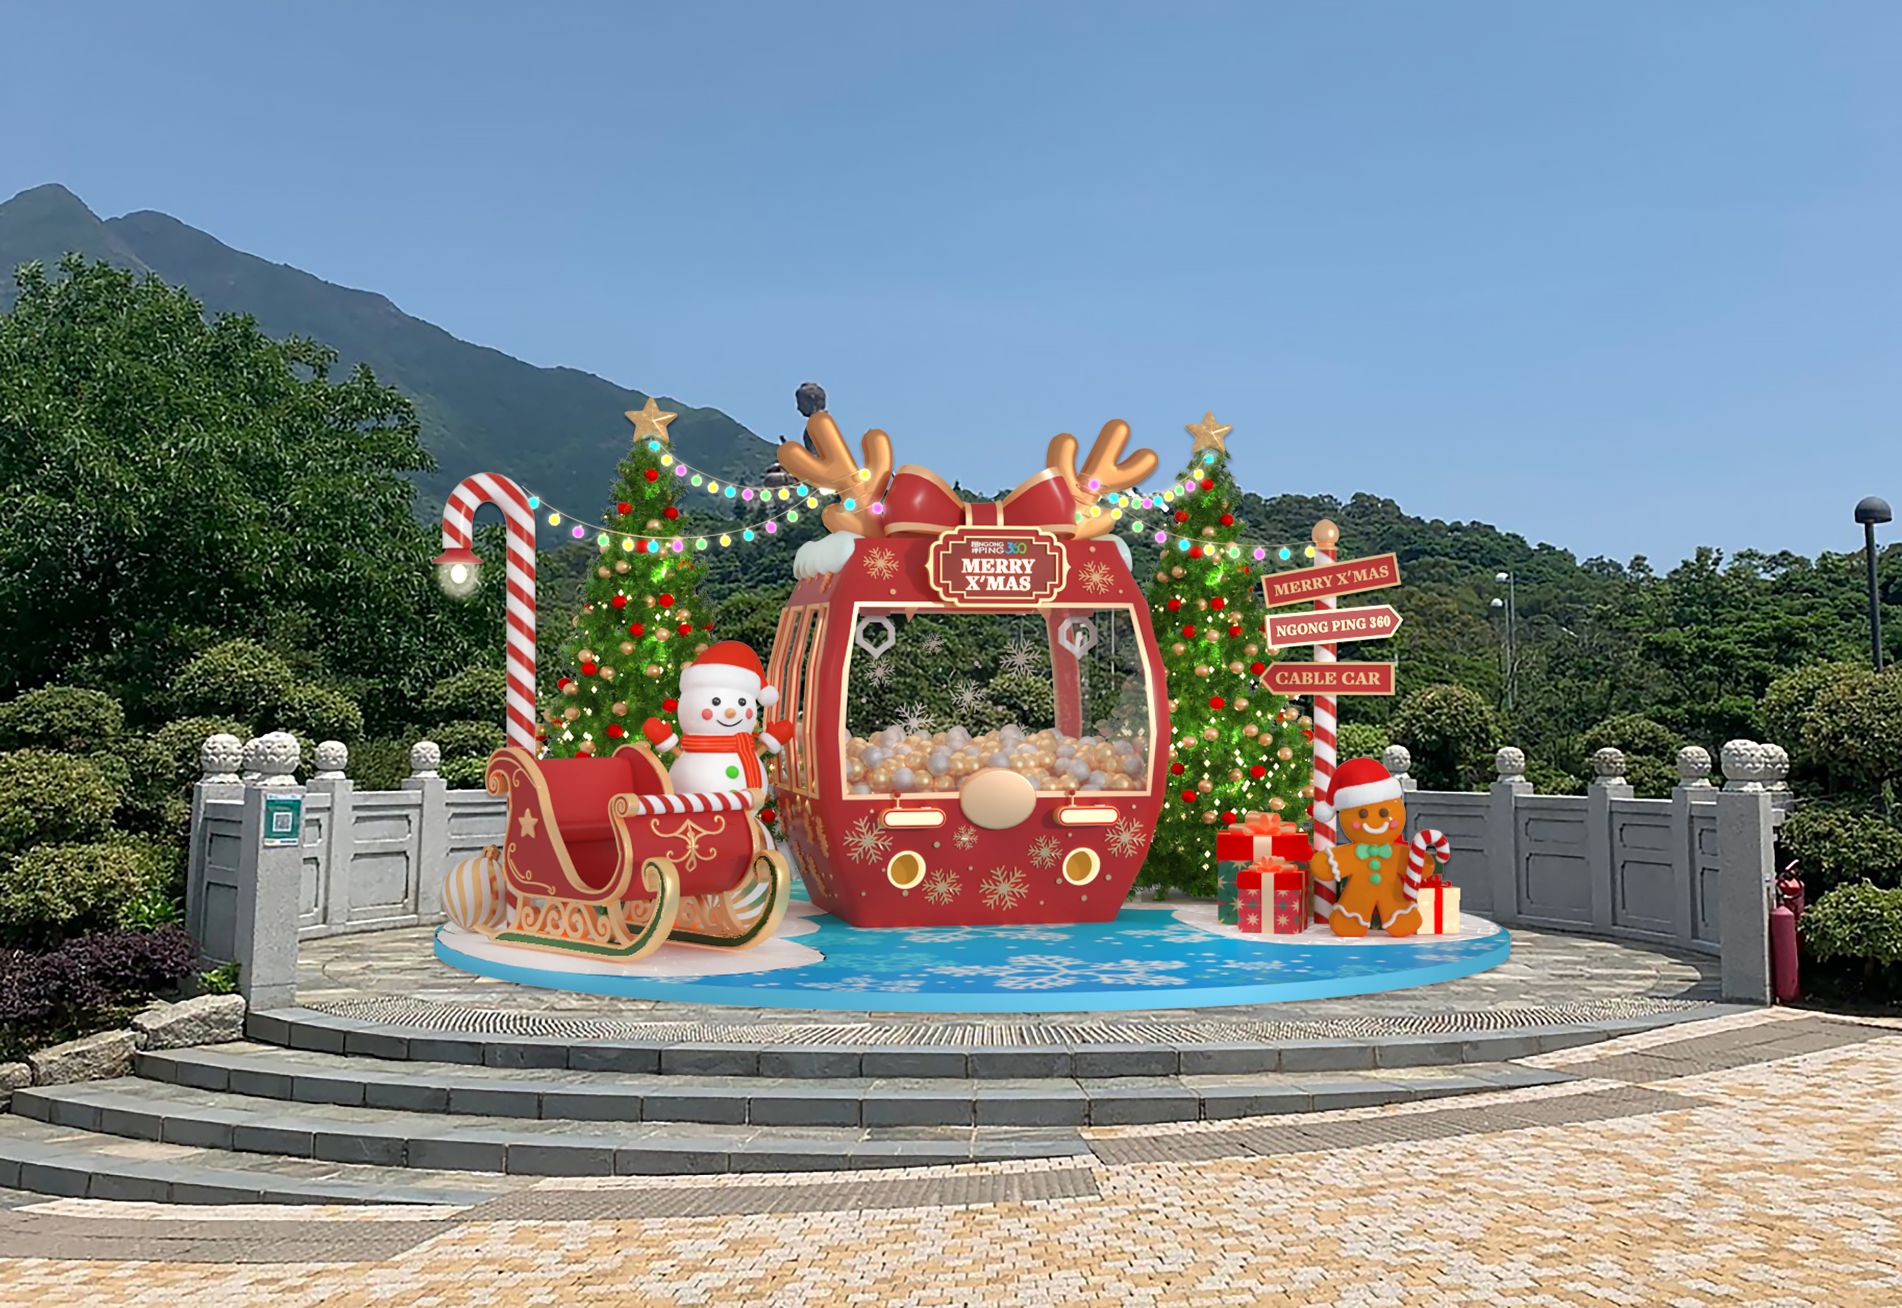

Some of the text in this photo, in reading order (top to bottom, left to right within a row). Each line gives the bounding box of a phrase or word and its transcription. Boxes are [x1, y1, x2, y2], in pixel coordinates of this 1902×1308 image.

[1005, 542, 1028, 554] 360
[961, 558, 1036, 574] MERRY
[965, 576, 1031, 591] X'MAS
[1273, 565, 1389, 597] MERRY X'MAS
[1275, 615, 1391, 637] NGONG PING 360
[1275, 671, 1381, 686] CABLE CAR
